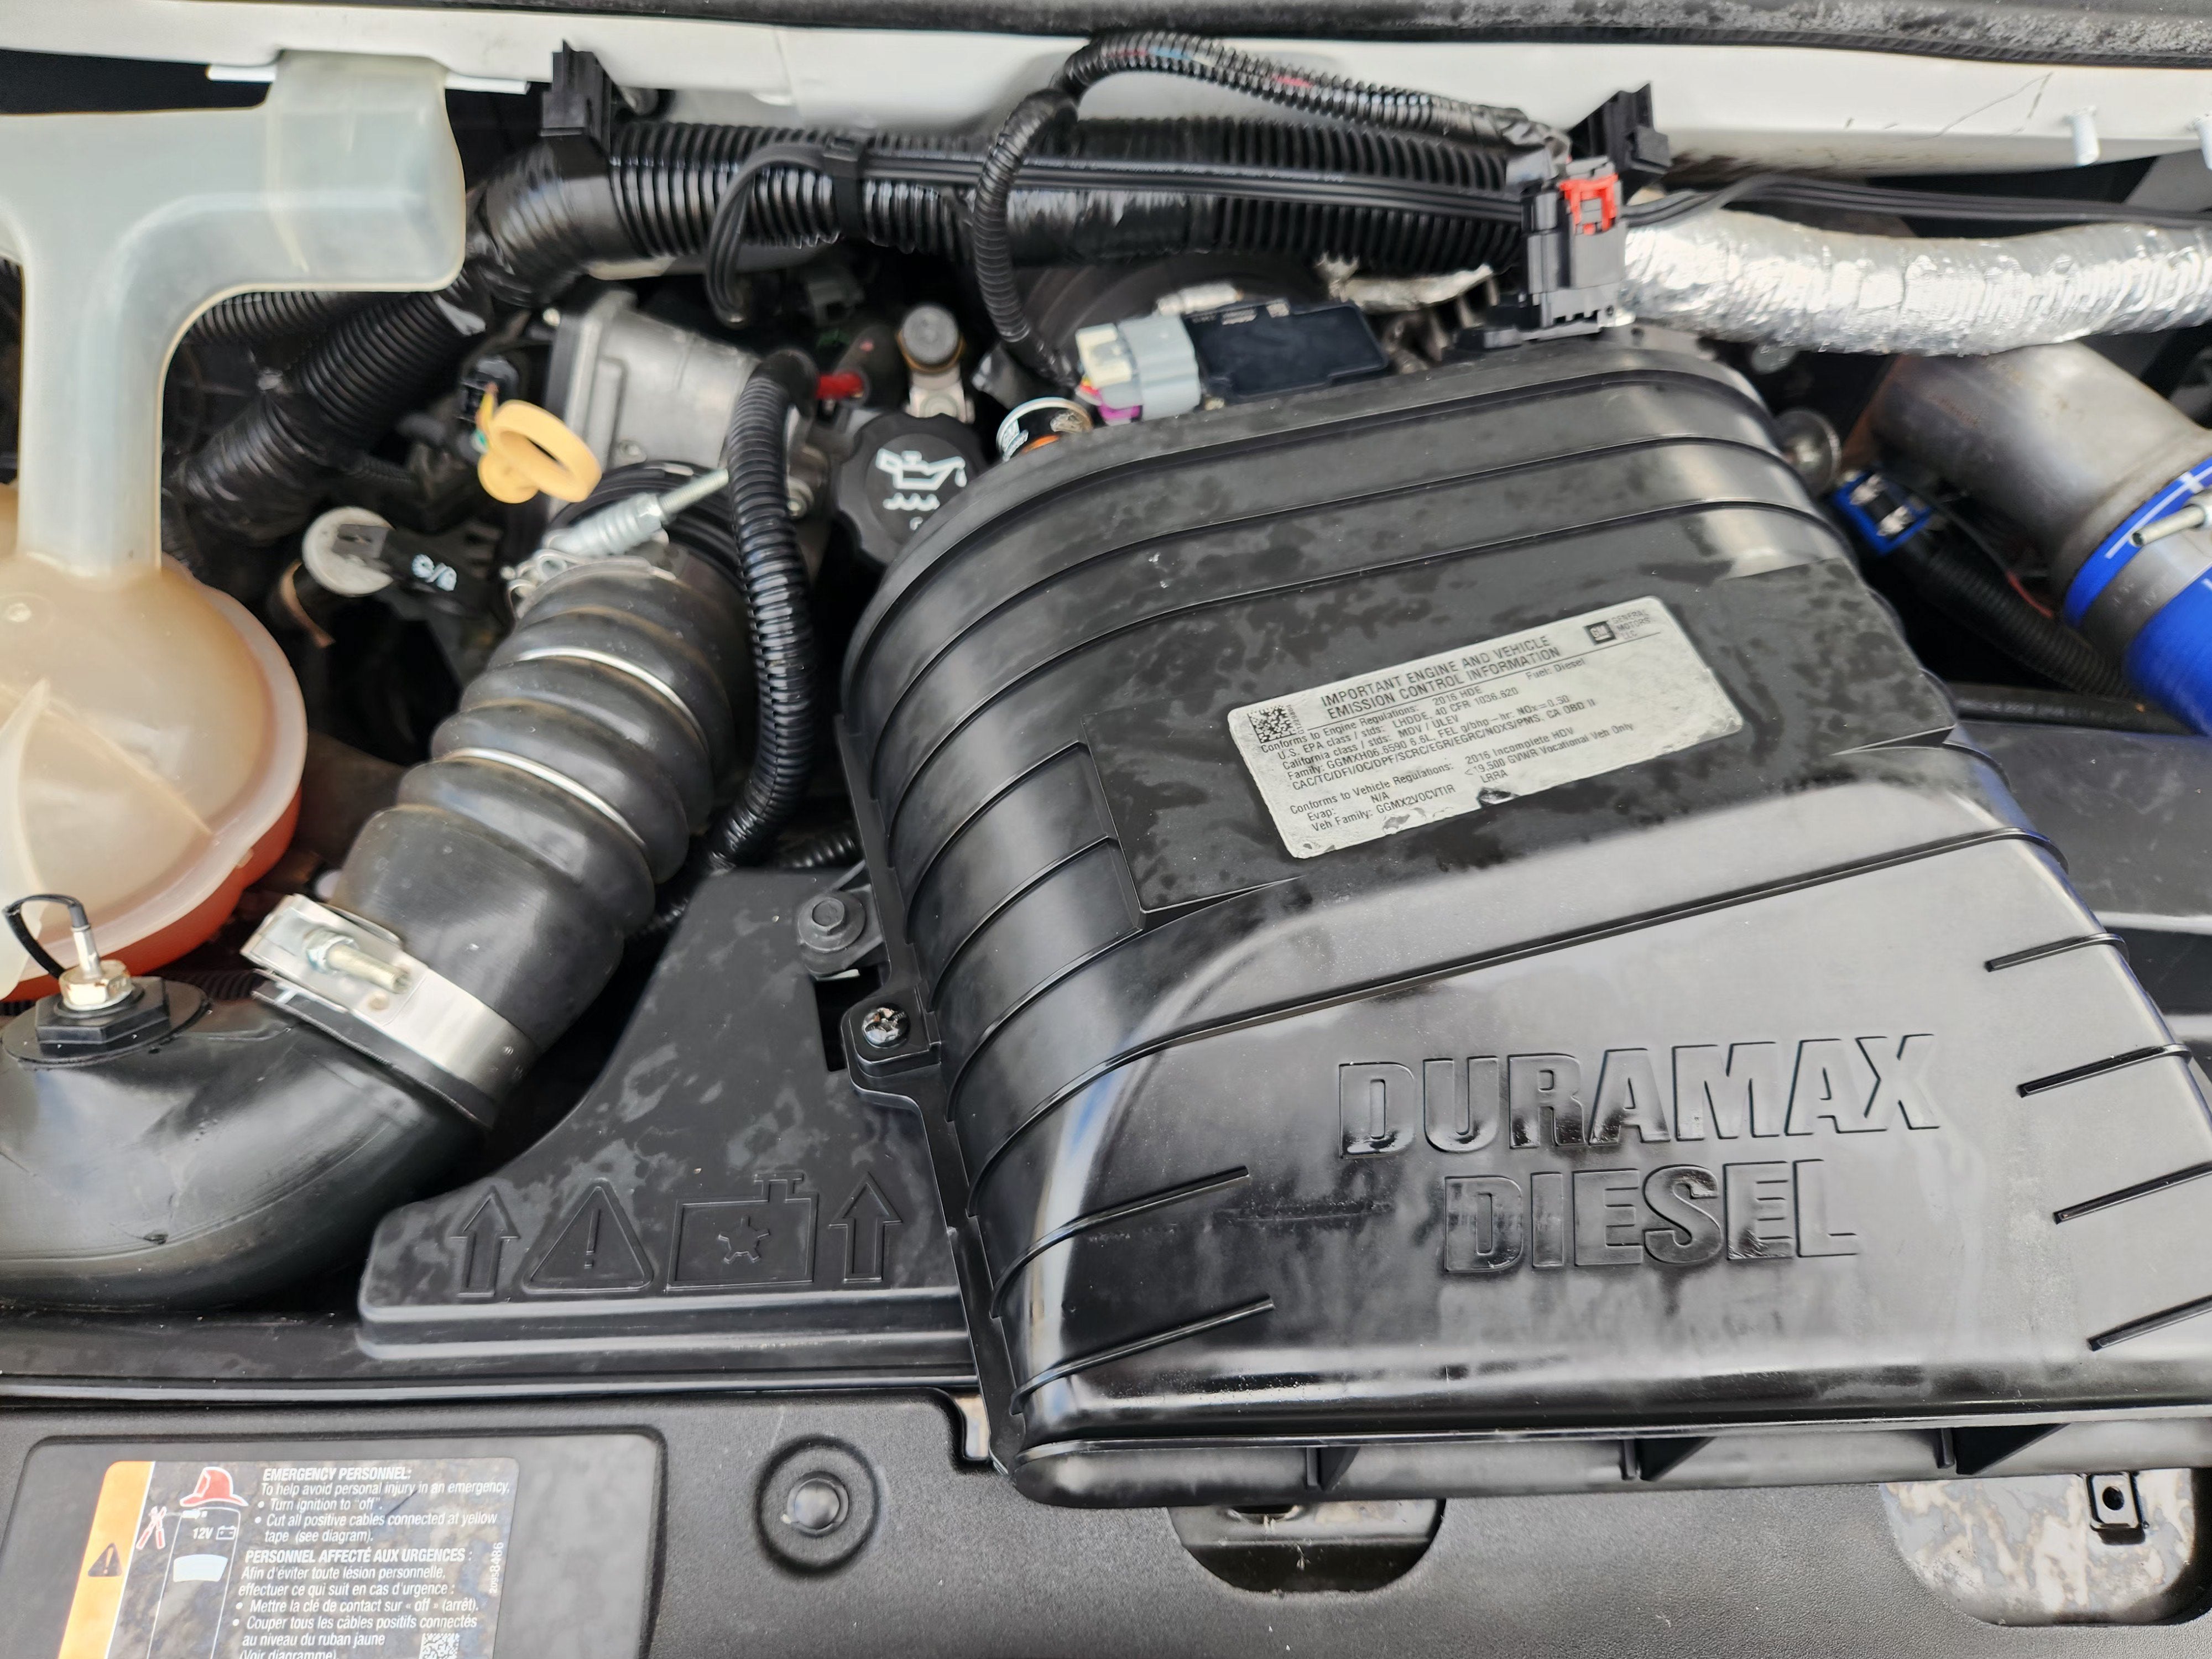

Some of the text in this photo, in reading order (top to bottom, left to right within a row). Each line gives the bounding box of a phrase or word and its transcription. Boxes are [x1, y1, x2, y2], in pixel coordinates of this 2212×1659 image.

[1616, 617, 1651, 631] MOTORS
[1321, 635, 1550, 707] IMPORTANT ENGINE AND VEHICLE
[1525, 658, 1585, 680] Fuel: Diesel
[1327, 647, 1561, 719] EMISSION CONTROL INFORMATION
[1432, 686, 1482, 706] 2016 HDE
[1546, 709, 1561, 719] CA
[1563, 702, 1585, 714] OBD
[1260, 735, 1308, 753] Conforms
[1322, 722, 1357, 736] Engine
[1359, 706, 1418, 726] Regulations:
[1277, 748, 1300, 760] U.S.
[1302, 741, 1324, 753] EPA
[1326, 735, 1352, 747] class
[1361, 726, 1385, 737] stds:
[1392, 712, 1432, 728] LHDDE,
[1435, 707, 1448, 716] 40
[1449, 700, 1471, 712] CFR
[1474, 687, 1519, 705] 1036.620
[1282, 752, 1331, 770] California
[1333, 744, 1358, 757] class
[1368, 735, 1391, 747] stds:
[1397, 724, 1422, 738] MDV
[1431, 714, 1459, 728] ULEV
[1465, 727, 1573, 765] 2016 Incomplete HDV
[1507, 748, 1539, 764] GVWR
[1538, 735, 1589, 754] Vocational
[1590, 729, 1610, 739] Veh
[1611, 723, 1634, 734] Only
[1287, 765, 1324, 780] Family:
[1437, 727, 1458, 738] FEL
[1480, 769, 1508, 783] LRRA
[1290, 764, 1453, 814] Conforms to Vehicle Regulations:
[1370, 791, 1390, 803] N/A
[1307, 808, 1336, 821] Evap:
[1311, 820, 1333, 831] Veh
[1334, 810, 1373, 825] Family:
[1338, 1034, 1942, 1160] DURAMAX
[1443, 1158, 1859, 1274] DIESEL
[263, 1467, 411, 1481] EMERGENCY PERSONNEL:
[262, 1483, 274, 1495] To
[278, 1483, 300, 1496] help
[302, 1483, 332, 1495] avoid
[334, 1482, 382, 1497] personal
[385, 1481, 416, 1496] injury
[418, 1481, 428, 1494] in
[430, 1483, 445, 1494] an
[270, 1498, 294, 1510] Turn
[296, 1498, 337, 1513] ignition
[340, 1499, 351, 1511] to
[267, 1512, 498, 1528] Cut all positive cables connected at yellow
[193, 1527, 214, 1540] 12V
[265, 1528, 373, 1544] tape (see diagram).
[244, 1550, 316, 1563] PERSONNEL
[319, 1547, 372, 1563] AFFECTÉ
[373, 1549, 399, 1563] AUX
[401, 1548, 466, 1562] URGENCES
[241, 1566, 264, 1580] Afin
[267, 1566, 310, 1580] d'éviter
[311, 1567, 340, 1579] toute
[342, 1566, 375, 1579] lésion
[238, 1583, 288, 1597] effectuer
[291, 1584, 305, 1596] ce
[308, 1583, 326, 1598] qui
[328, 1583, 349, 1596] suit
[352, 1584, 367, 1595] en
[369, 1584, 389, 1595] cas
[392, 1582, 448, 1598] d'urgence
[250, 1599, 286, 1612] Mettre
[290, 1599, 299, 1612] la
[302, 1599, 320, 1612] clé
[322, 1599, 337, 1612] de
[339, 1599, 382, 1612] contact
[384, 1600, 403, 1612] sur
[414, 1598, 431, 1611] off
[442, 1597, 479, 1614] (arrêt).
[247, 1614, 478, 1631] Couper tous les câbles positifs connectés
[242, 1632, 386, 1648] au niveau du ruban jaune
[240, 1650, 340, 1659] (Voir diagramme)
